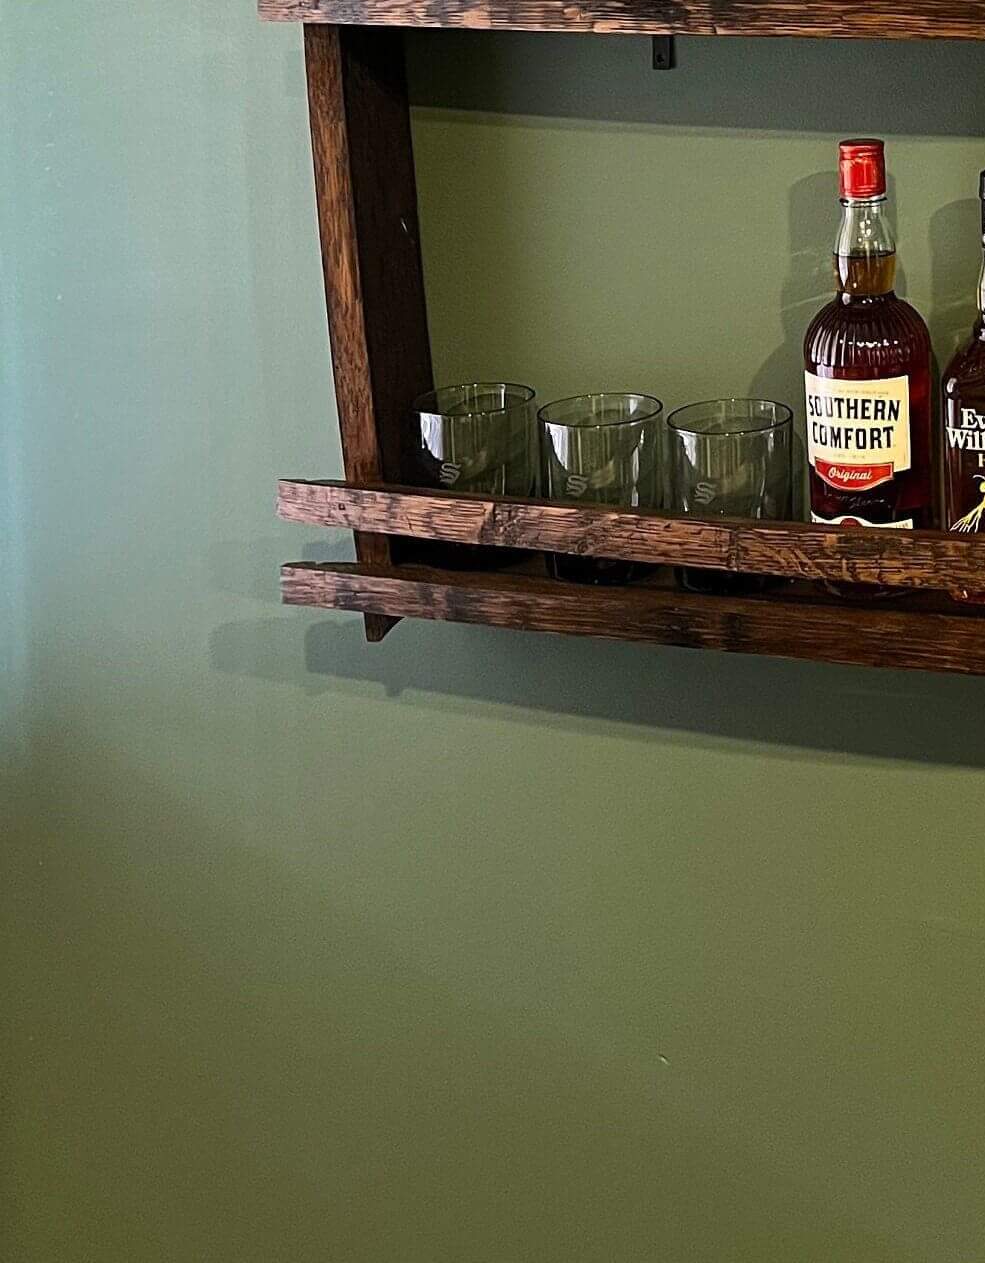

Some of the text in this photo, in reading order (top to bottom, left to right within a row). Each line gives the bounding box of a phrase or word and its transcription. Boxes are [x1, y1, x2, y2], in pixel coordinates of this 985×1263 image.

[808, 394, 902, 421] SOUTHERN
[812, 421, 894, 450] COMFORT
[827, 466, 873, 482] Original
